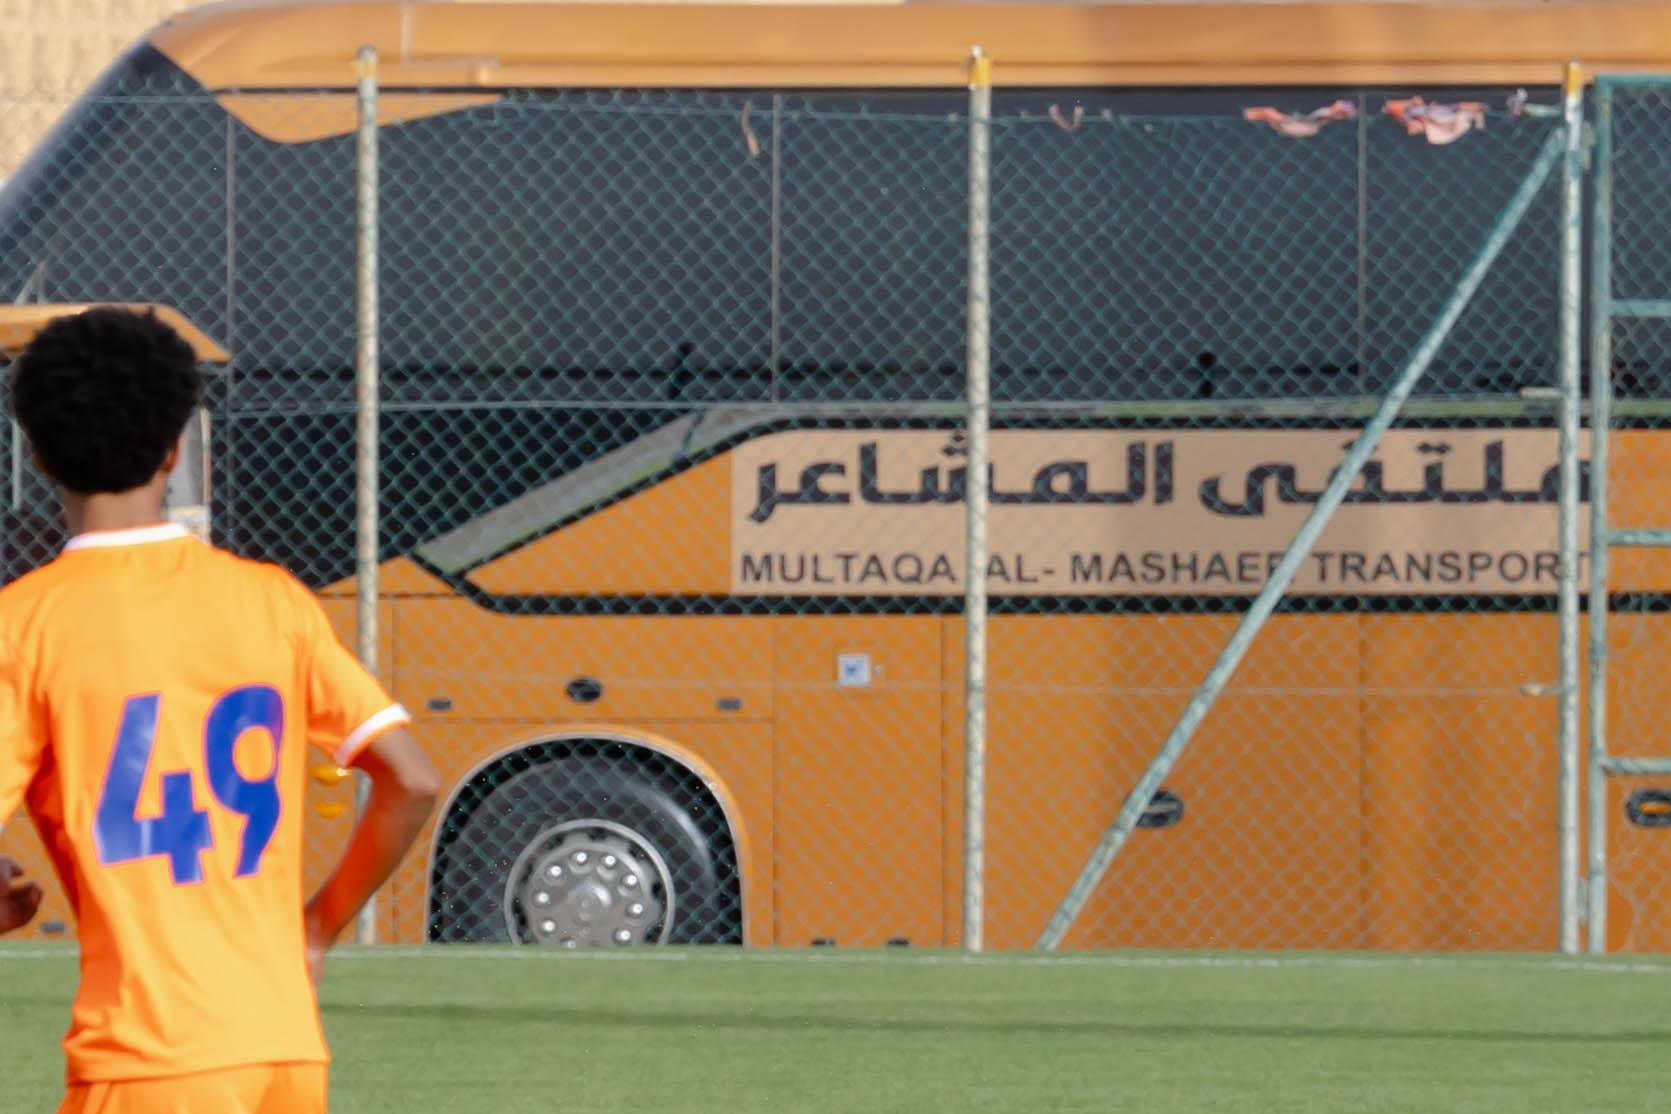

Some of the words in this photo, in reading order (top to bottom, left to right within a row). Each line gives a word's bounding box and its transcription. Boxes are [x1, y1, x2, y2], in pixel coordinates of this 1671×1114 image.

[748, 433, 1173, 523] المشاعر
[740, 553, 957, 583] MULTAQA
[92, 682, 285, 886] 49
